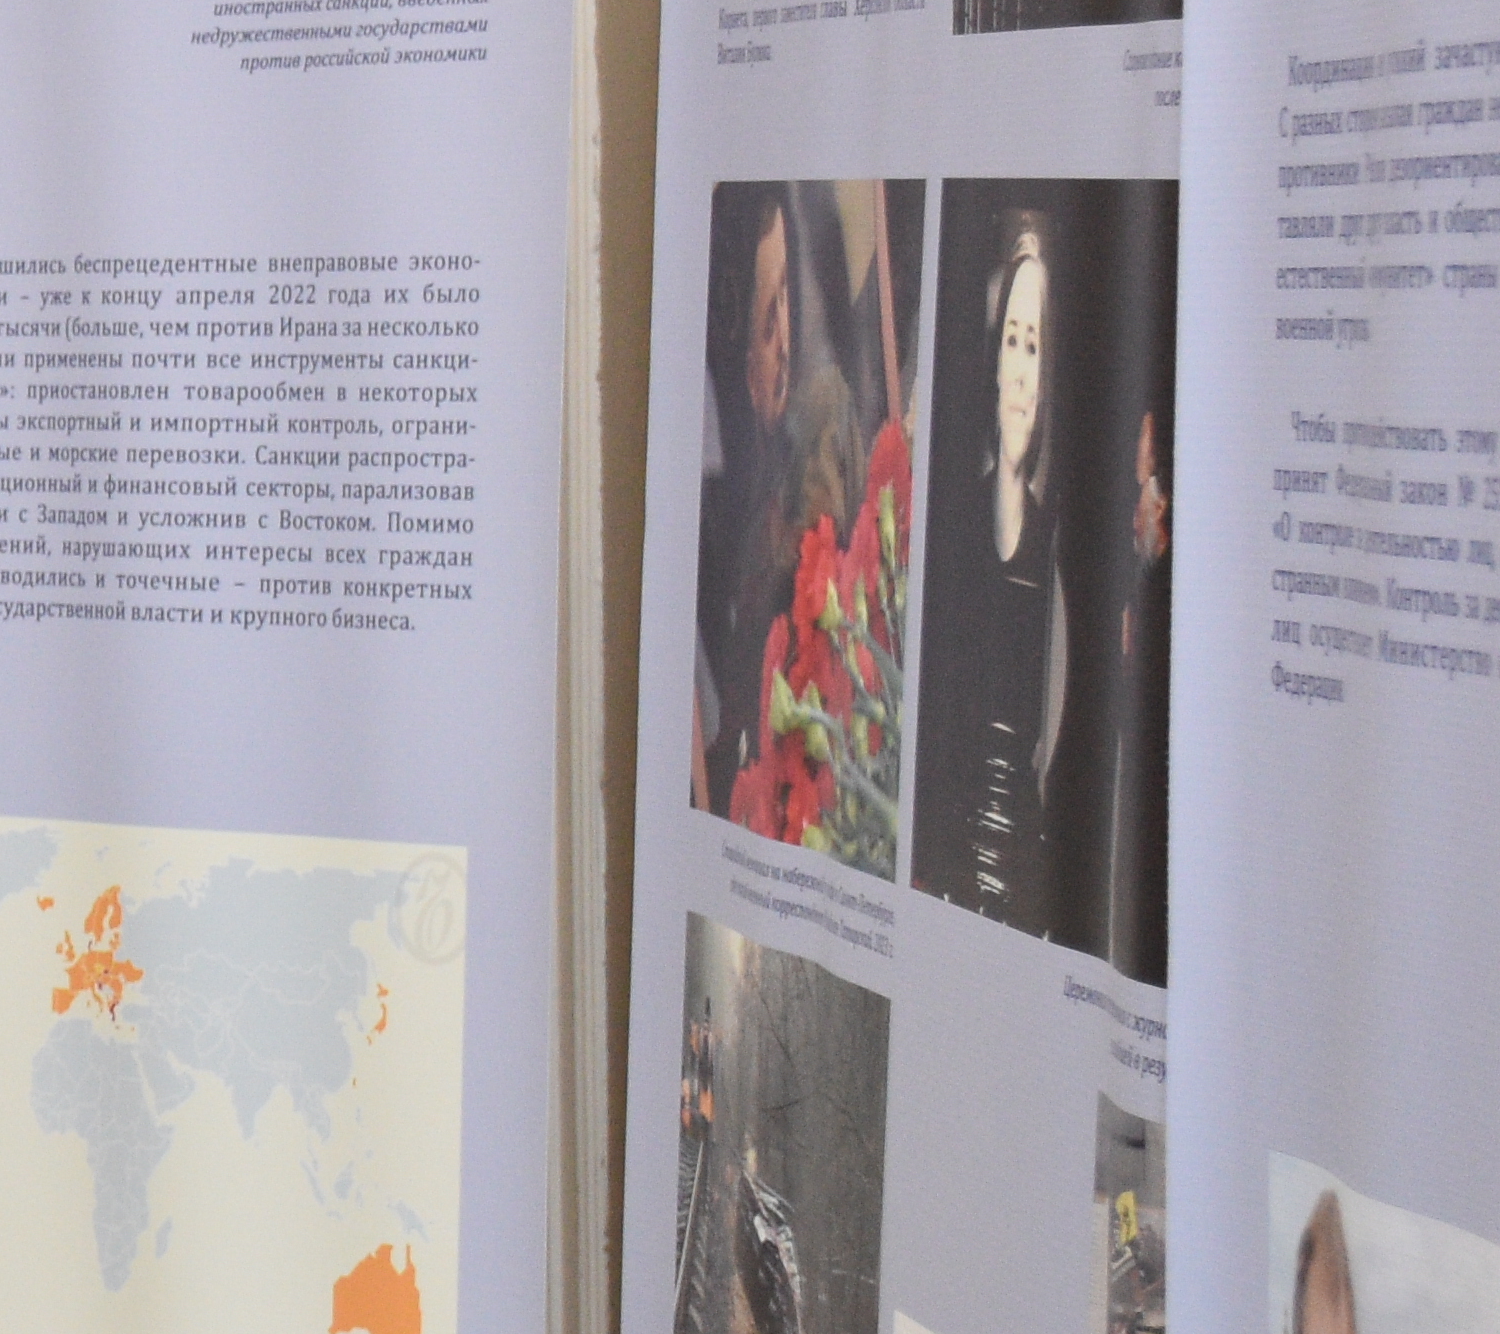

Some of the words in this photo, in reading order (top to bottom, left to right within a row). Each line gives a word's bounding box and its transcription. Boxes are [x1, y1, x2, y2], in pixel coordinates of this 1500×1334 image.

[190, 24, 353, 49] недружественными
[355, 17, 489, 41] государствами
[240, 54, 302, 76] против
[303, 46, 391, 74] российской
[394, 47, 488, 65] экономики
[73, 252, 258, 281] беспрецедентные
[267, 254, 399, 279] внеправовые
[408, 253, 481, 273] эконо-
[39, 289, 73, 312] уже
[81, 289, 92, 307] к
[100, 288, 163, 311] концу
[175, 288, 256, 312] апреля
[268, 282, 317, 307] 2022
[328, 287, 372, 308] года
[383, 287, 410, 305] их
[422, 281, 481, 305] было
